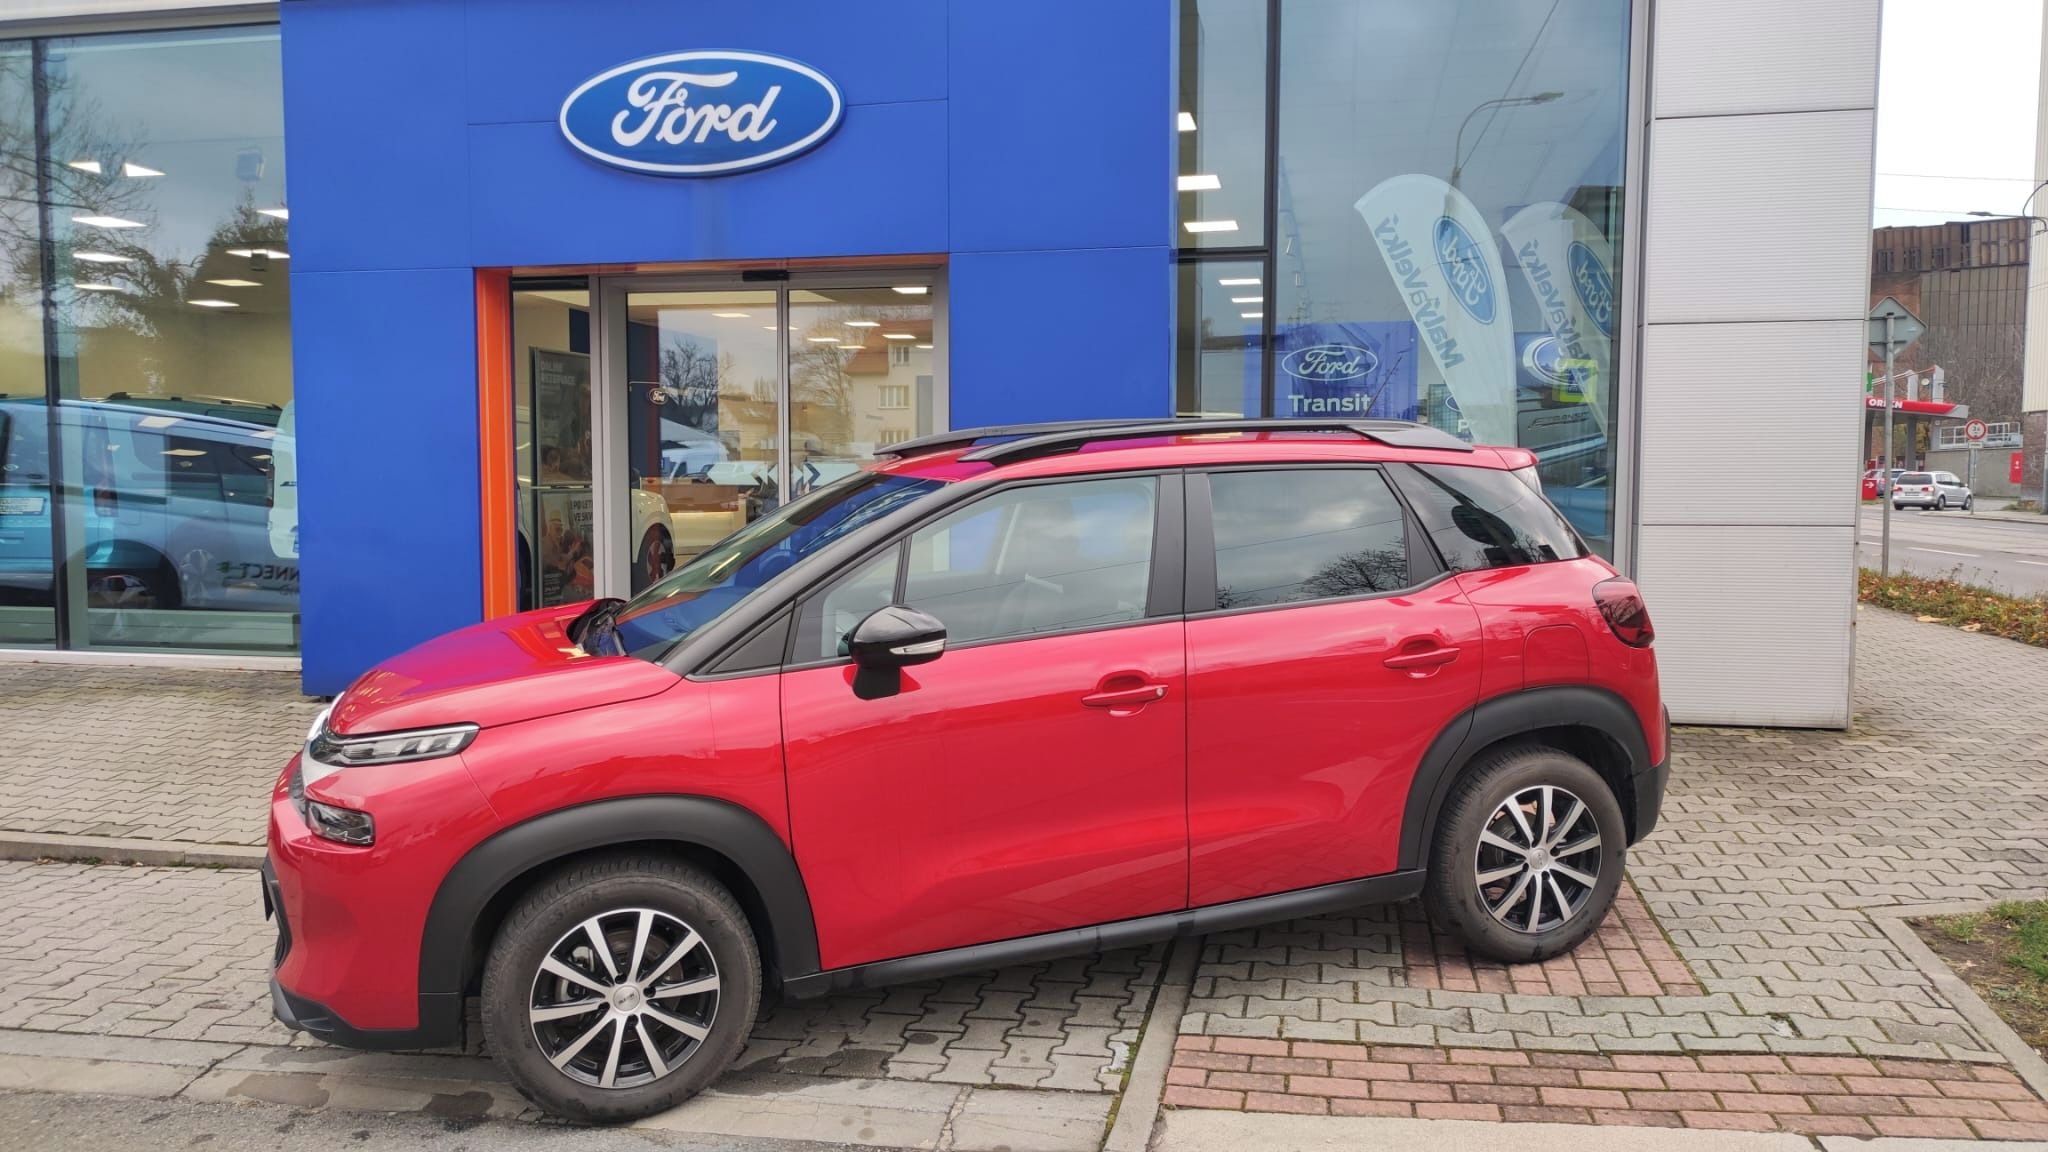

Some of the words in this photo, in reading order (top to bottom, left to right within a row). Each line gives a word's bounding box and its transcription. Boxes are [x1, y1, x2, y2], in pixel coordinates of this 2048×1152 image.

[611, 71, 782, 147] Ford
[1299, 350, 1361, 375] Ford
[1288, 393, 1371, 413] Transit
[1868, 399, 1903, 408] ORN
